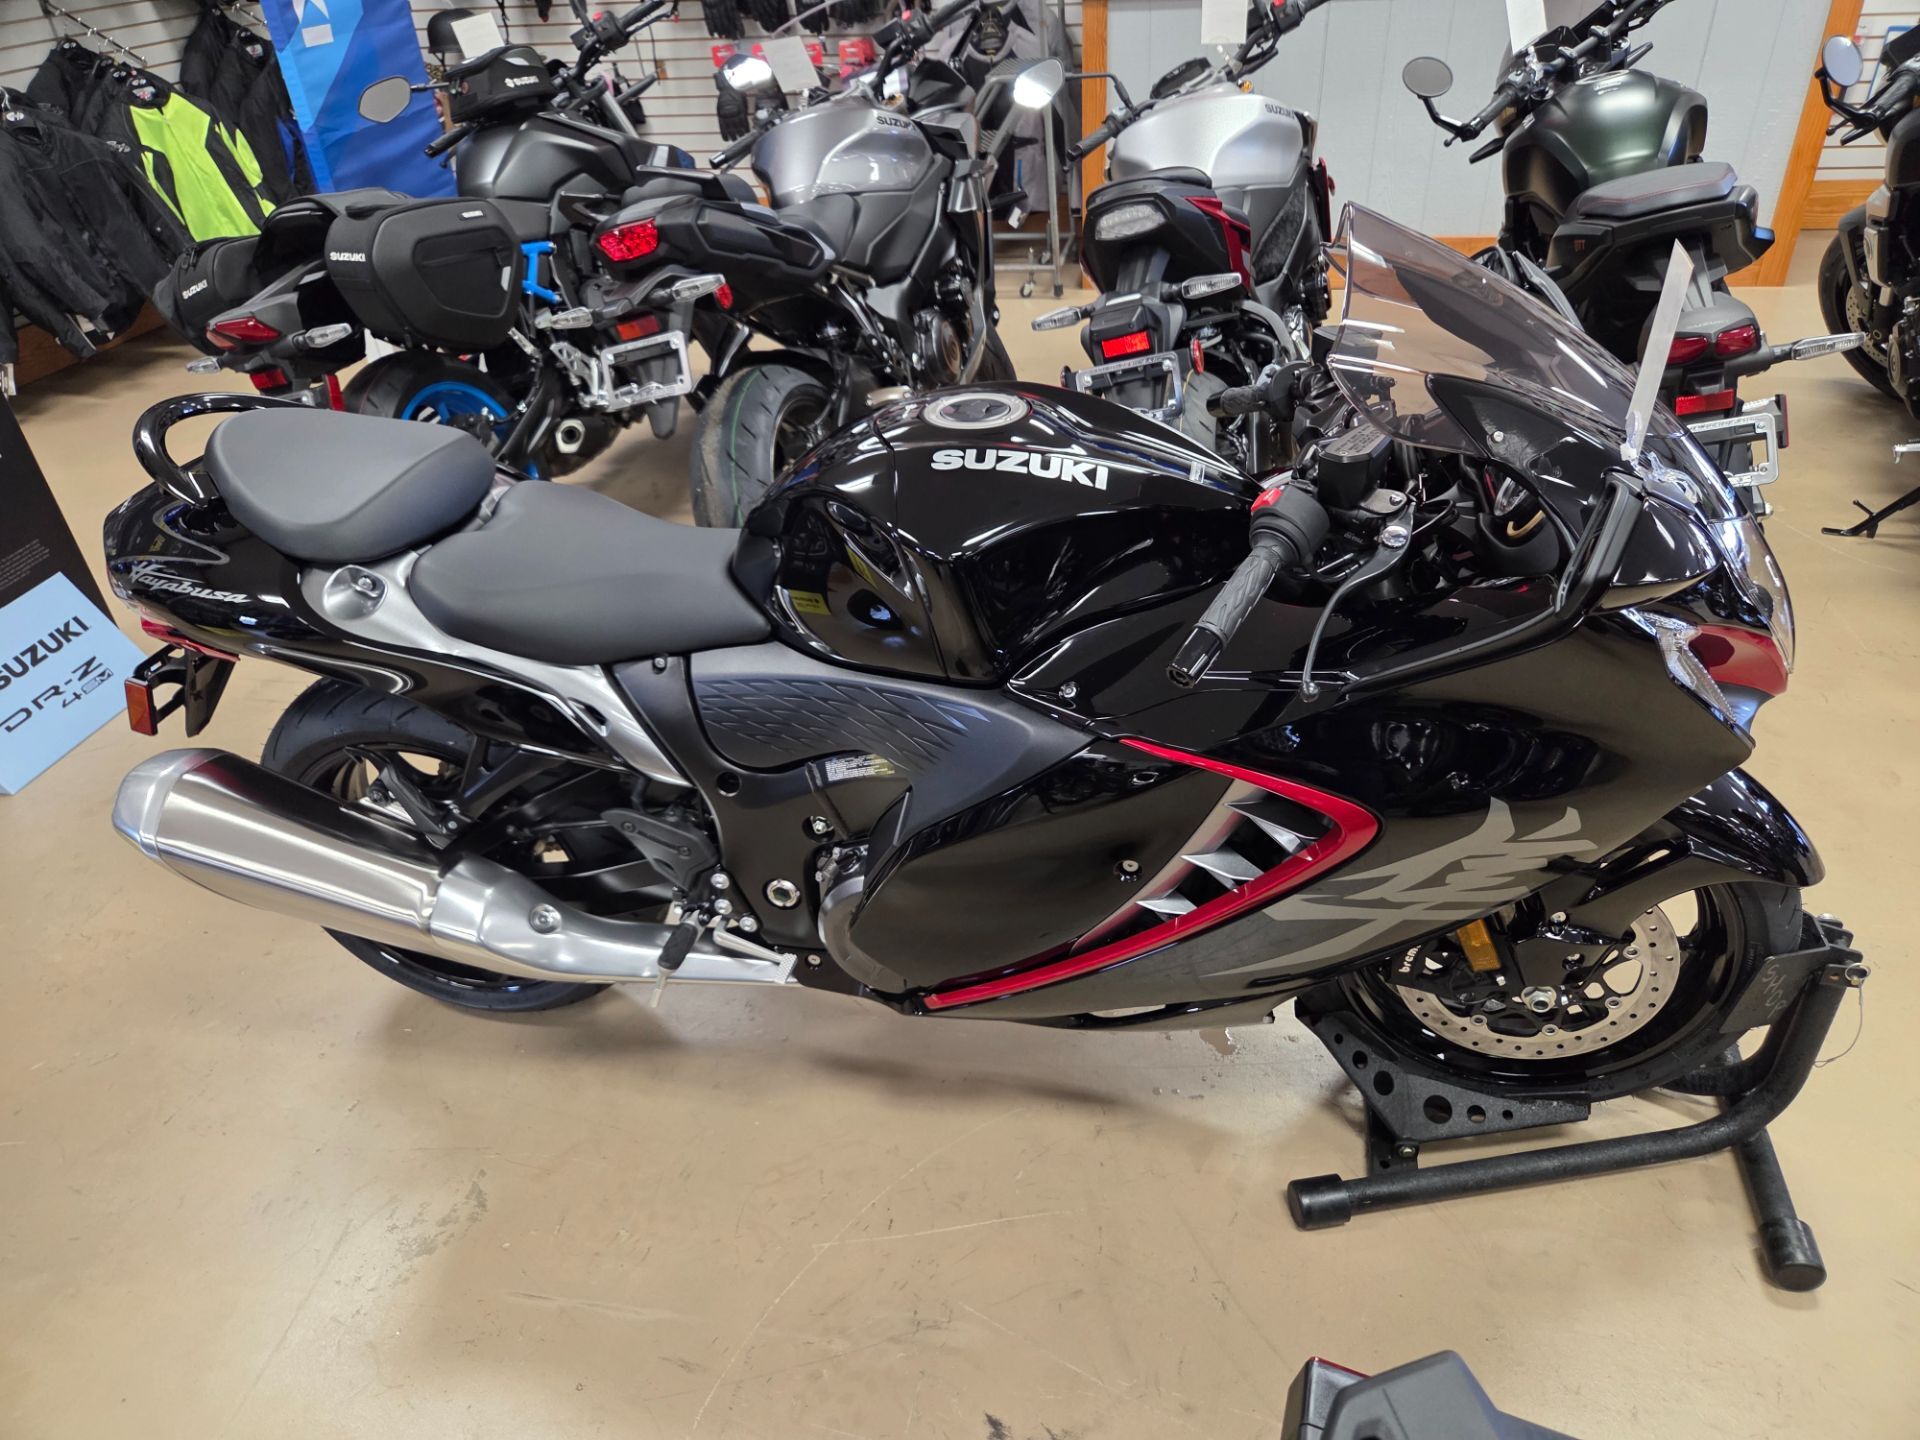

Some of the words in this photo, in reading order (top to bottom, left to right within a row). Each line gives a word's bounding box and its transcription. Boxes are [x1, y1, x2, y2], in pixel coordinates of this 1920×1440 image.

[330, 251, 366, 262] SUZUKI
[182, 279, 208, 300] SUZUKI
[930, 448, 1109, 491] SUZUKI
[128, 561, 252, 603] Hayabusa
[0, 615, 90, 691] SUZUKI
[1398, 944, 1421, 973] brem
